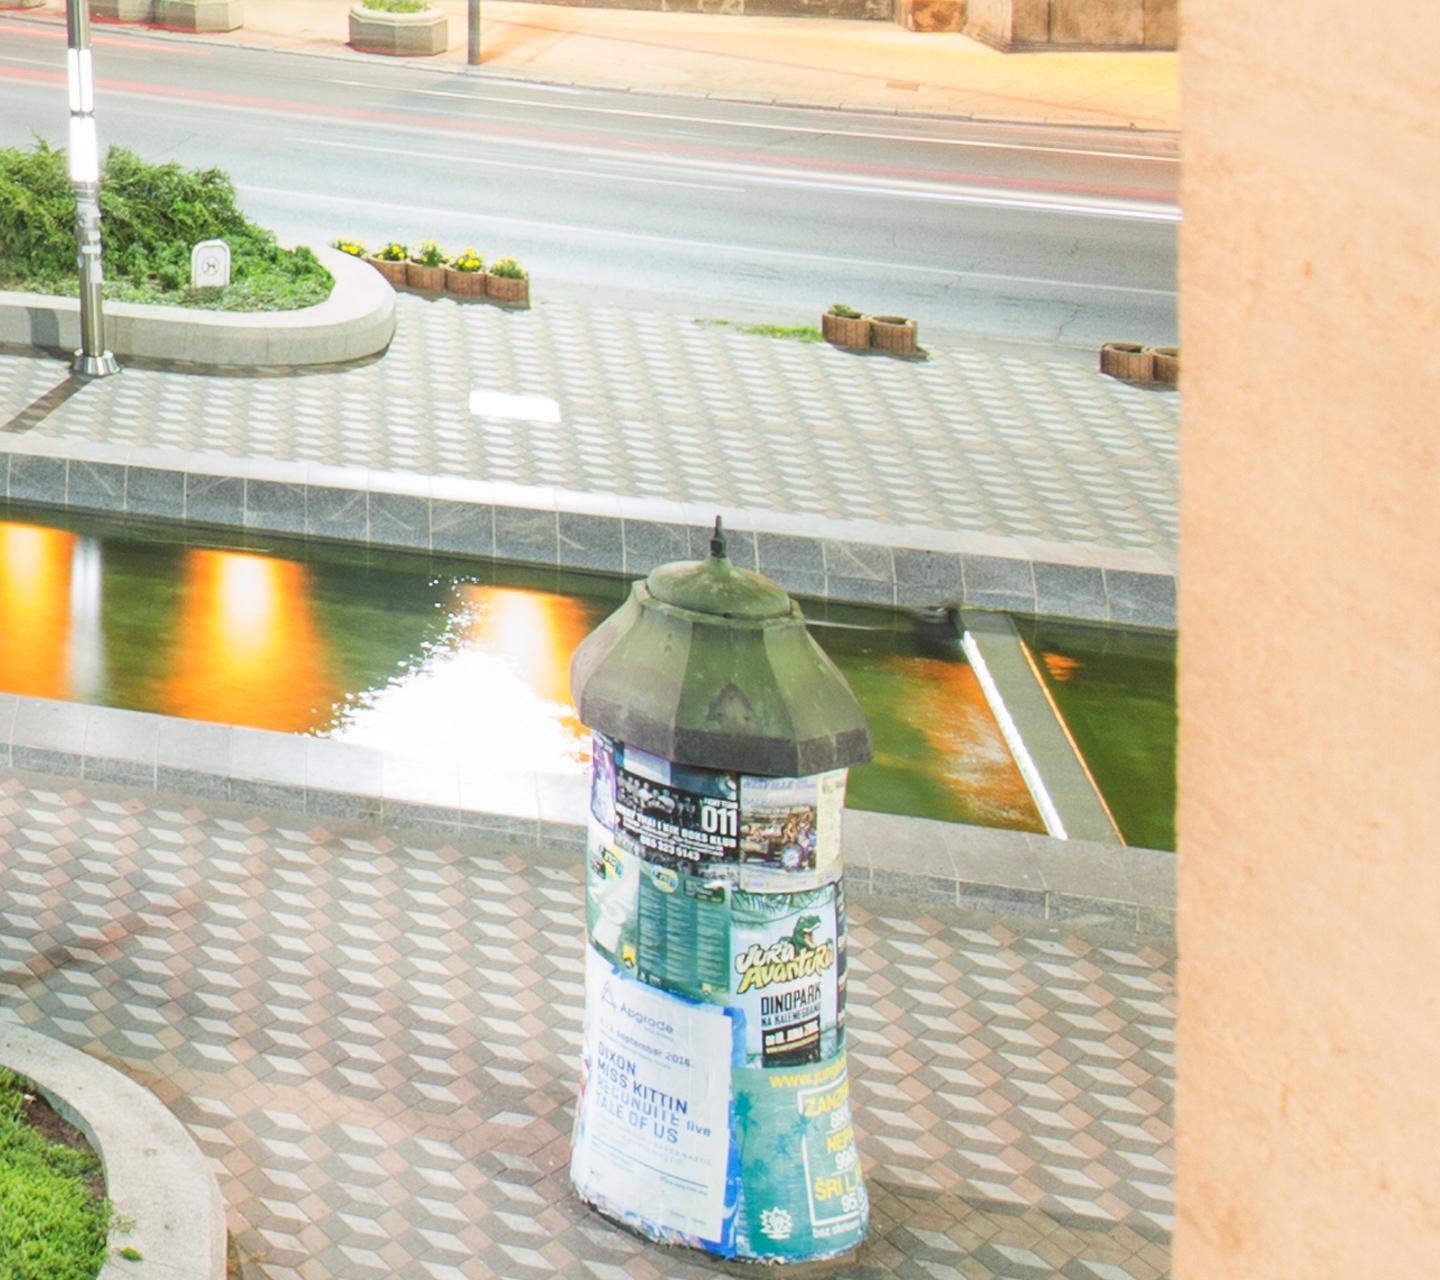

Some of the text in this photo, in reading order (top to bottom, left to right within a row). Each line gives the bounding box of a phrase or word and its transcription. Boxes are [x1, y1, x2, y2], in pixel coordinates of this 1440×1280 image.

[701, 805, 738, 837] 011
[761, 983, 822, 1017] DINOPARK
[598, 1040, 636, 1077] DIXON
[597, 1057, 688, 1114] MISS KITTIN
[596, 1092, 679, 1144] TALE OF US
[686, 1120, 712, 1137] live
